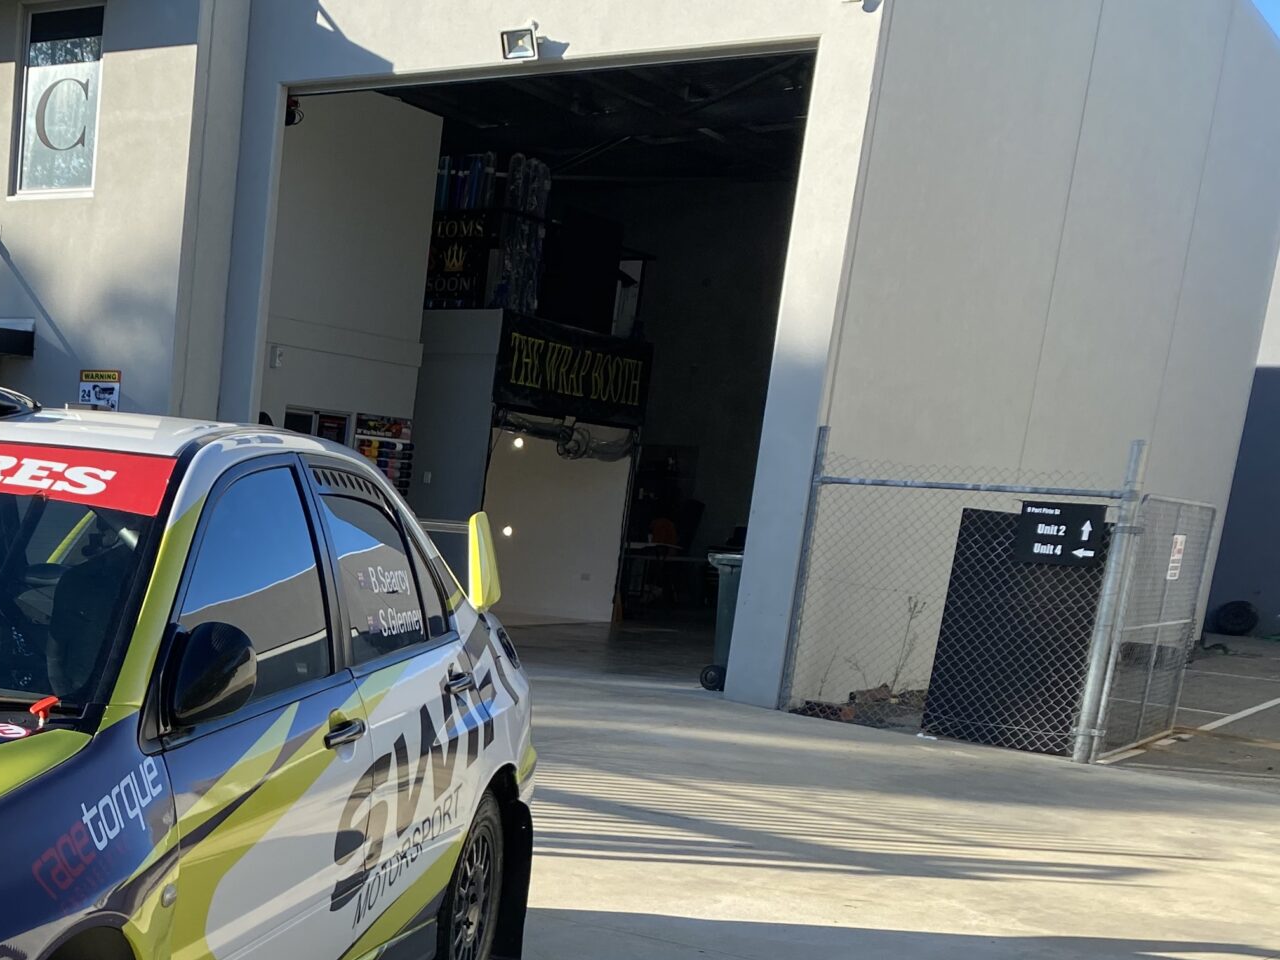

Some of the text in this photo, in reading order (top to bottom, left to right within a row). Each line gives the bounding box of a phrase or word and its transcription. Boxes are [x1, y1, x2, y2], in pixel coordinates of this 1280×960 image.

[35, 77, 90, 151] C
[510, 332, 643, 405] THE WRAP BOOTH
[83, 372, 117, 380] WARNING
[81, 389, 91, 399] 24
[1037, 523, 1067, 536] Unit 2
[1033, 542, 1063, 556] Unit 4
[352, 783, 463, 930] MOTORSPORT
